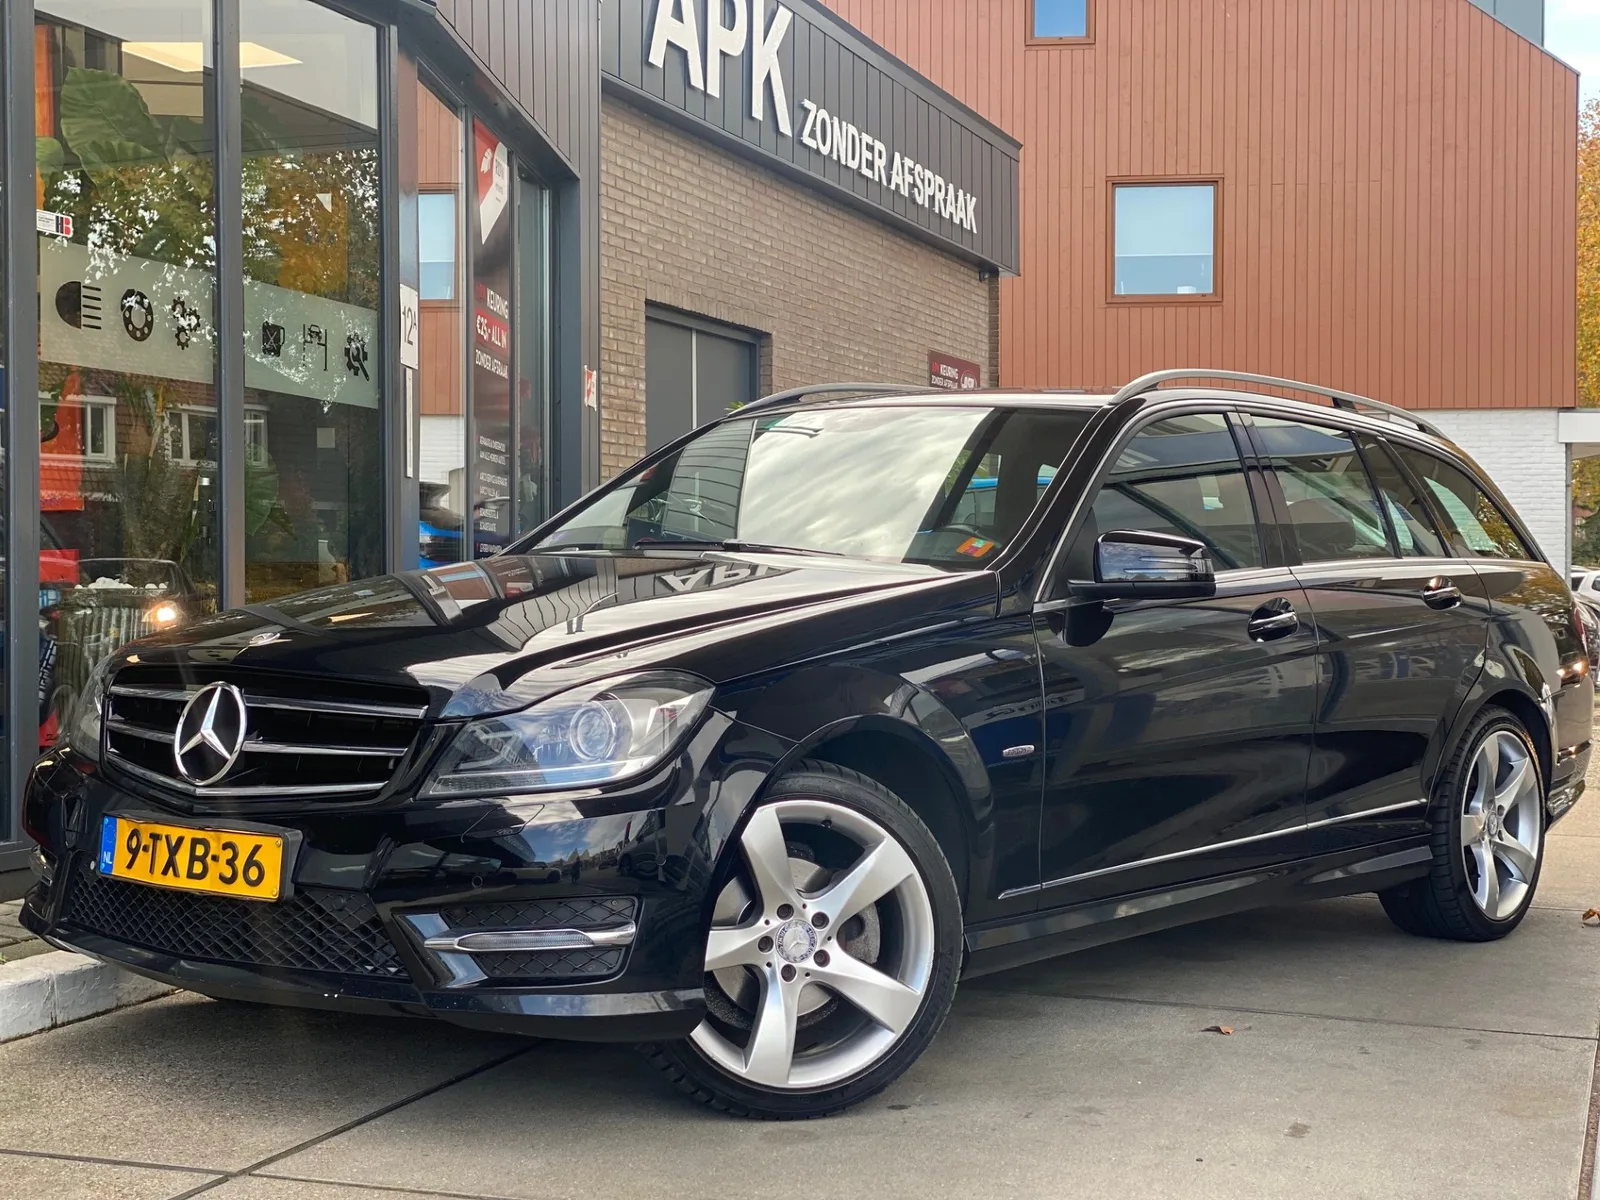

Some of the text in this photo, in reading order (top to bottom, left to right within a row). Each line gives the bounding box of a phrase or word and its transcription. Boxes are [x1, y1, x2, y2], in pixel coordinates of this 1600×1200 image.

[648, 0, 978, 234] APK ZONDER AFSPRAAK
[102, 850, 113, 865] NL
[126, 827, 266, 888] 9-TXB-36
